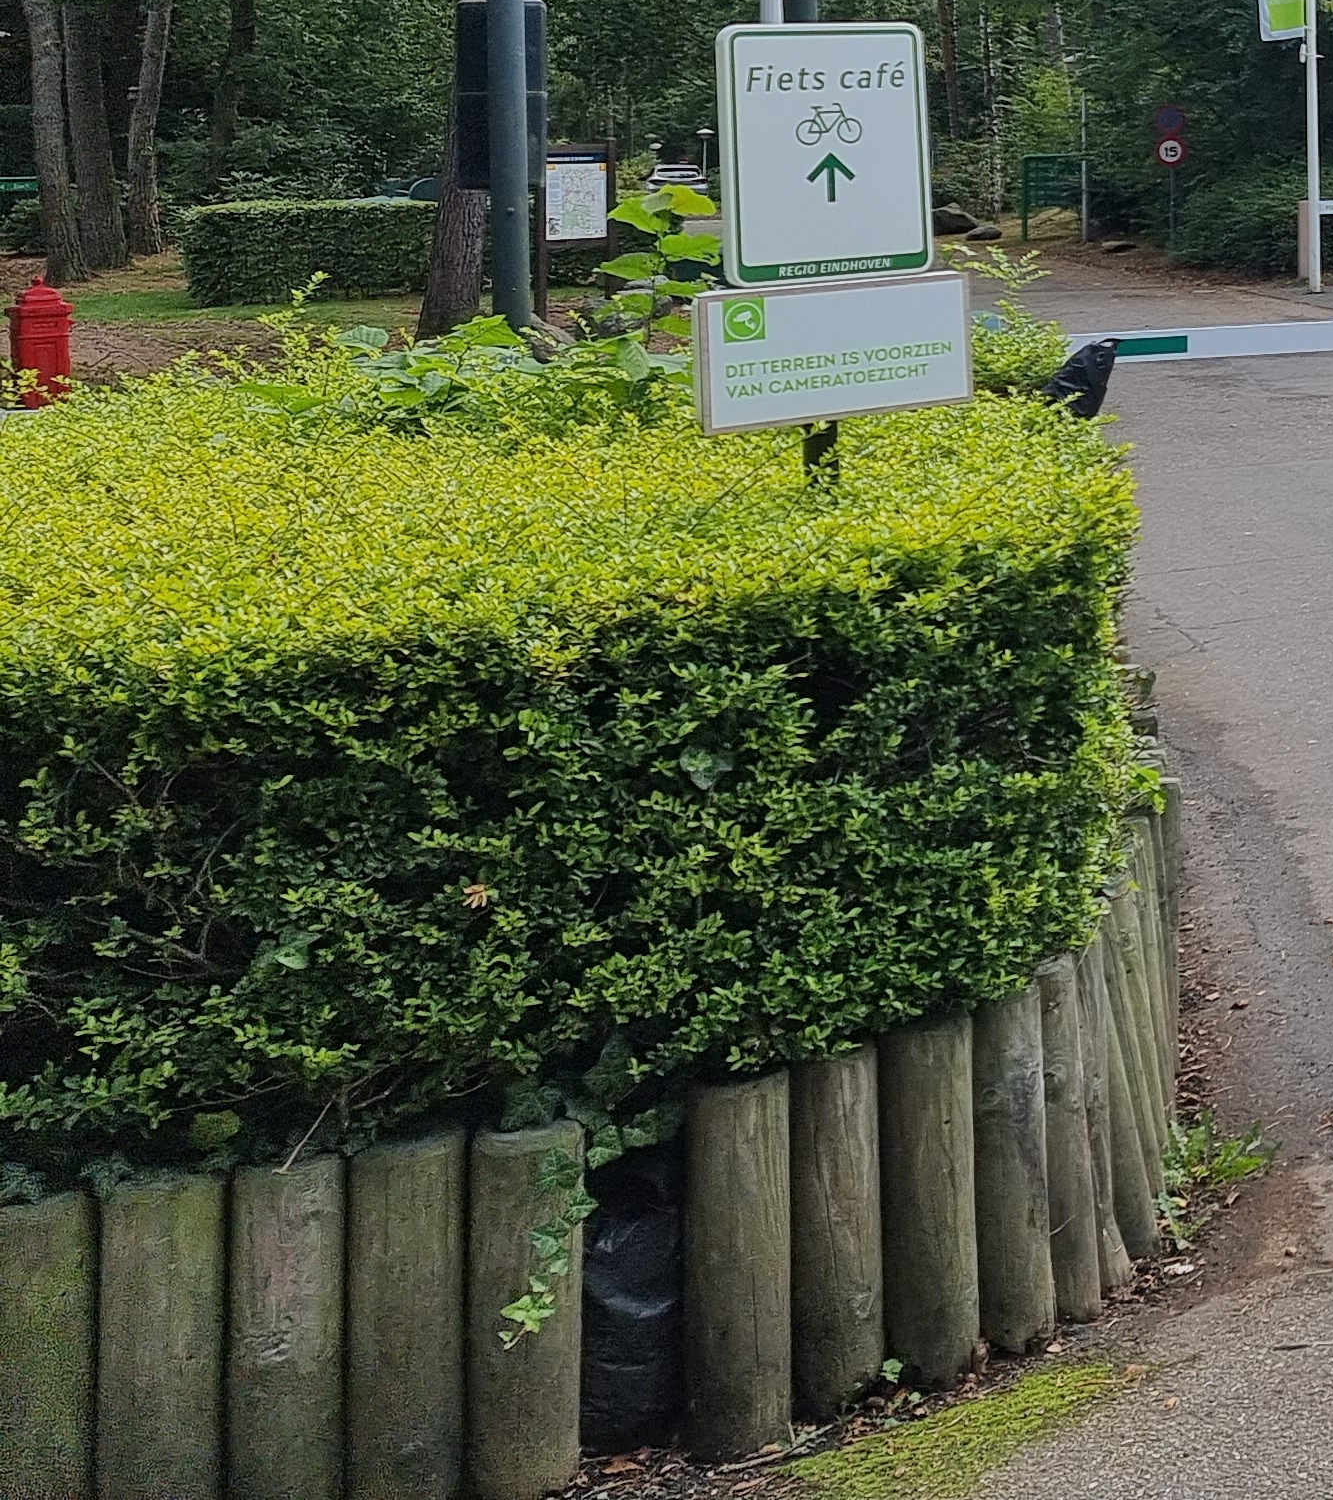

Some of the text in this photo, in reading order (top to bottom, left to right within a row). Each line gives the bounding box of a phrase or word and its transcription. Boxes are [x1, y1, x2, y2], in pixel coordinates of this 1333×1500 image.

[745, 61, 906, 92] Fiets café
[1164, 146, 1179, 158] 15
[778, 258, 891, 278] REGIO EINDHOVEN
[725, 341, 953, 380] DIT TERREIN IS VOORZIEN
[725, 364, 929, 399] VAN CAMERATOEZICHT
